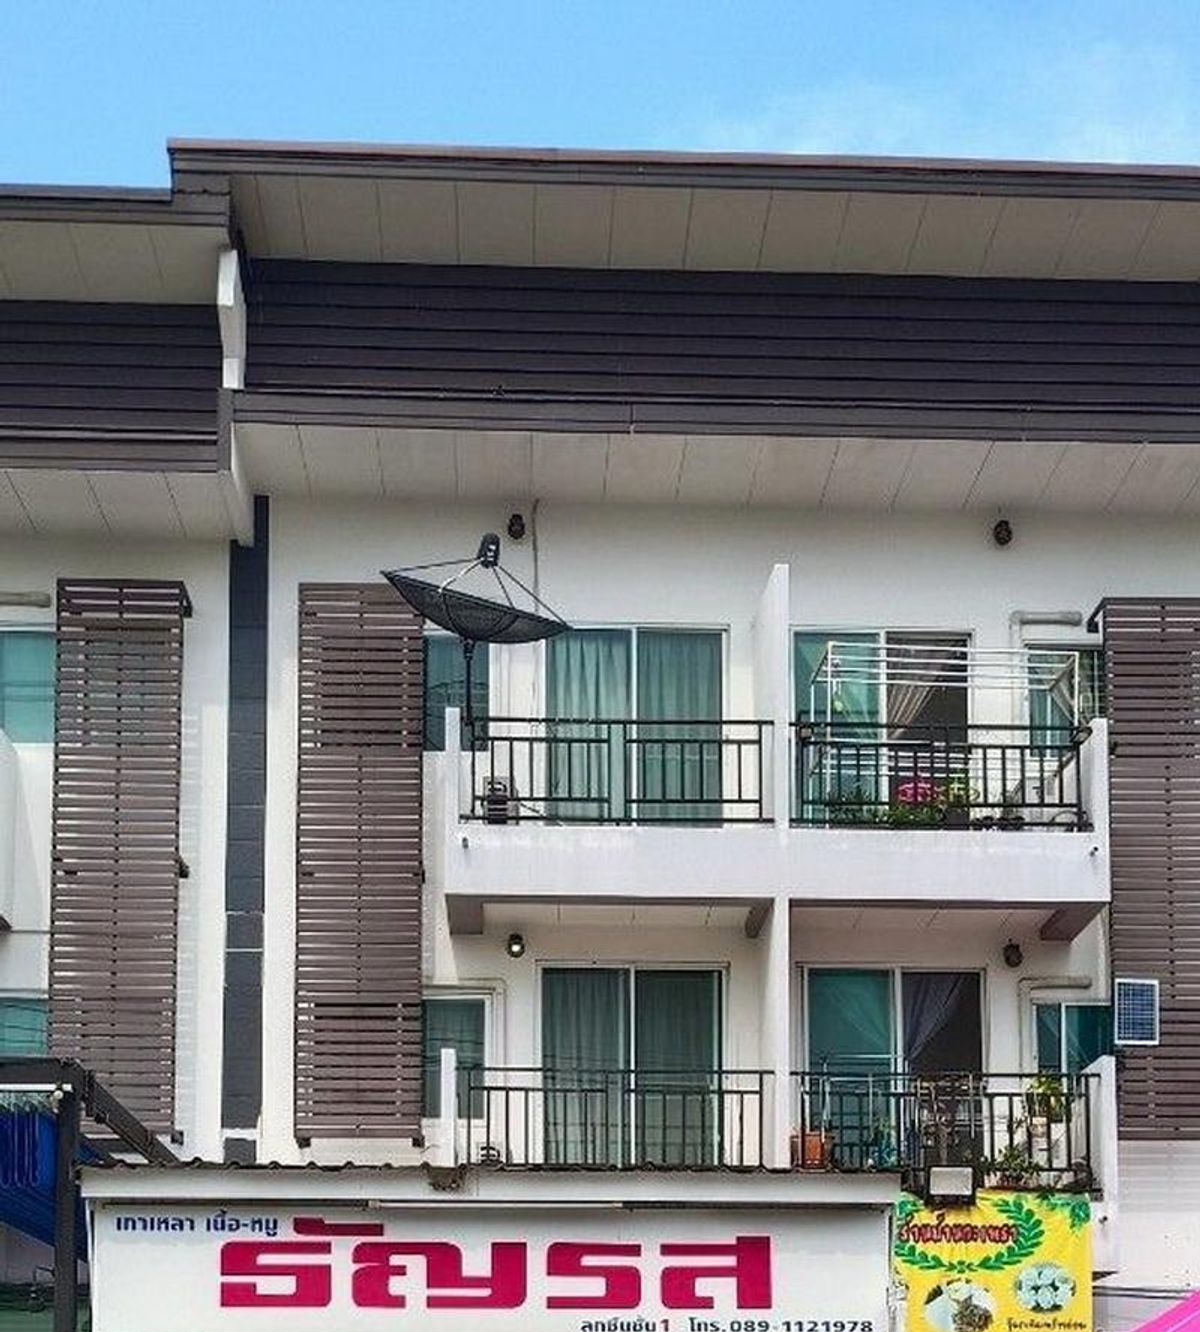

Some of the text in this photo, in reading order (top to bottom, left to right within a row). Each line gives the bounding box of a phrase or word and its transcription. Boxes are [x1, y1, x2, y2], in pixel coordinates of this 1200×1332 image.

[116, 1217, 195, 1231] เกาเหลา
[220, 1217, 773, 1309] ธัญรส
[660, 1319, 670, 1332] 1
